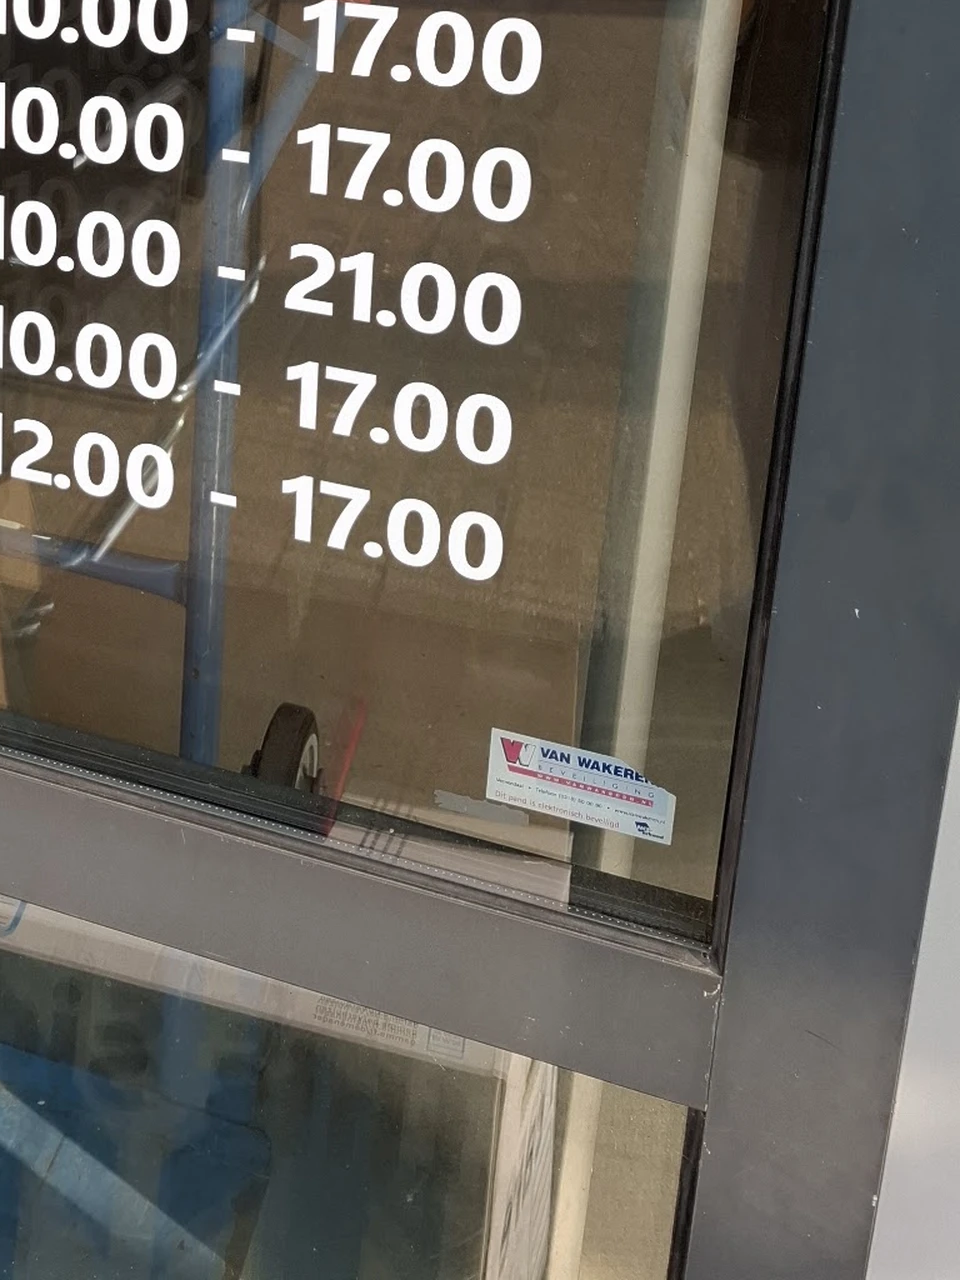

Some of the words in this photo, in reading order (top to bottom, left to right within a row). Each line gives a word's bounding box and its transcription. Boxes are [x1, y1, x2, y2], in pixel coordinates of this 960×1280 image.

[227, 29, 255, 42] -
[304, 0, 541, 94] 17.00
[223, 149, 249, 163] -
[298, 124, 530, 221] 17.00
[219, 266, 245, 280] -
[285, 244, 520, 344] 21.00
[215, 380, 240, 395] -
[287, 362, 511, 464] 17.00
[211, 492, 236, 506] -
[283, 476, 502, 580] 17.00
[495, 790, 507, 799] Dit
[508, 795, 527, 805] pand
[540, 746, 571, 765] VAN
